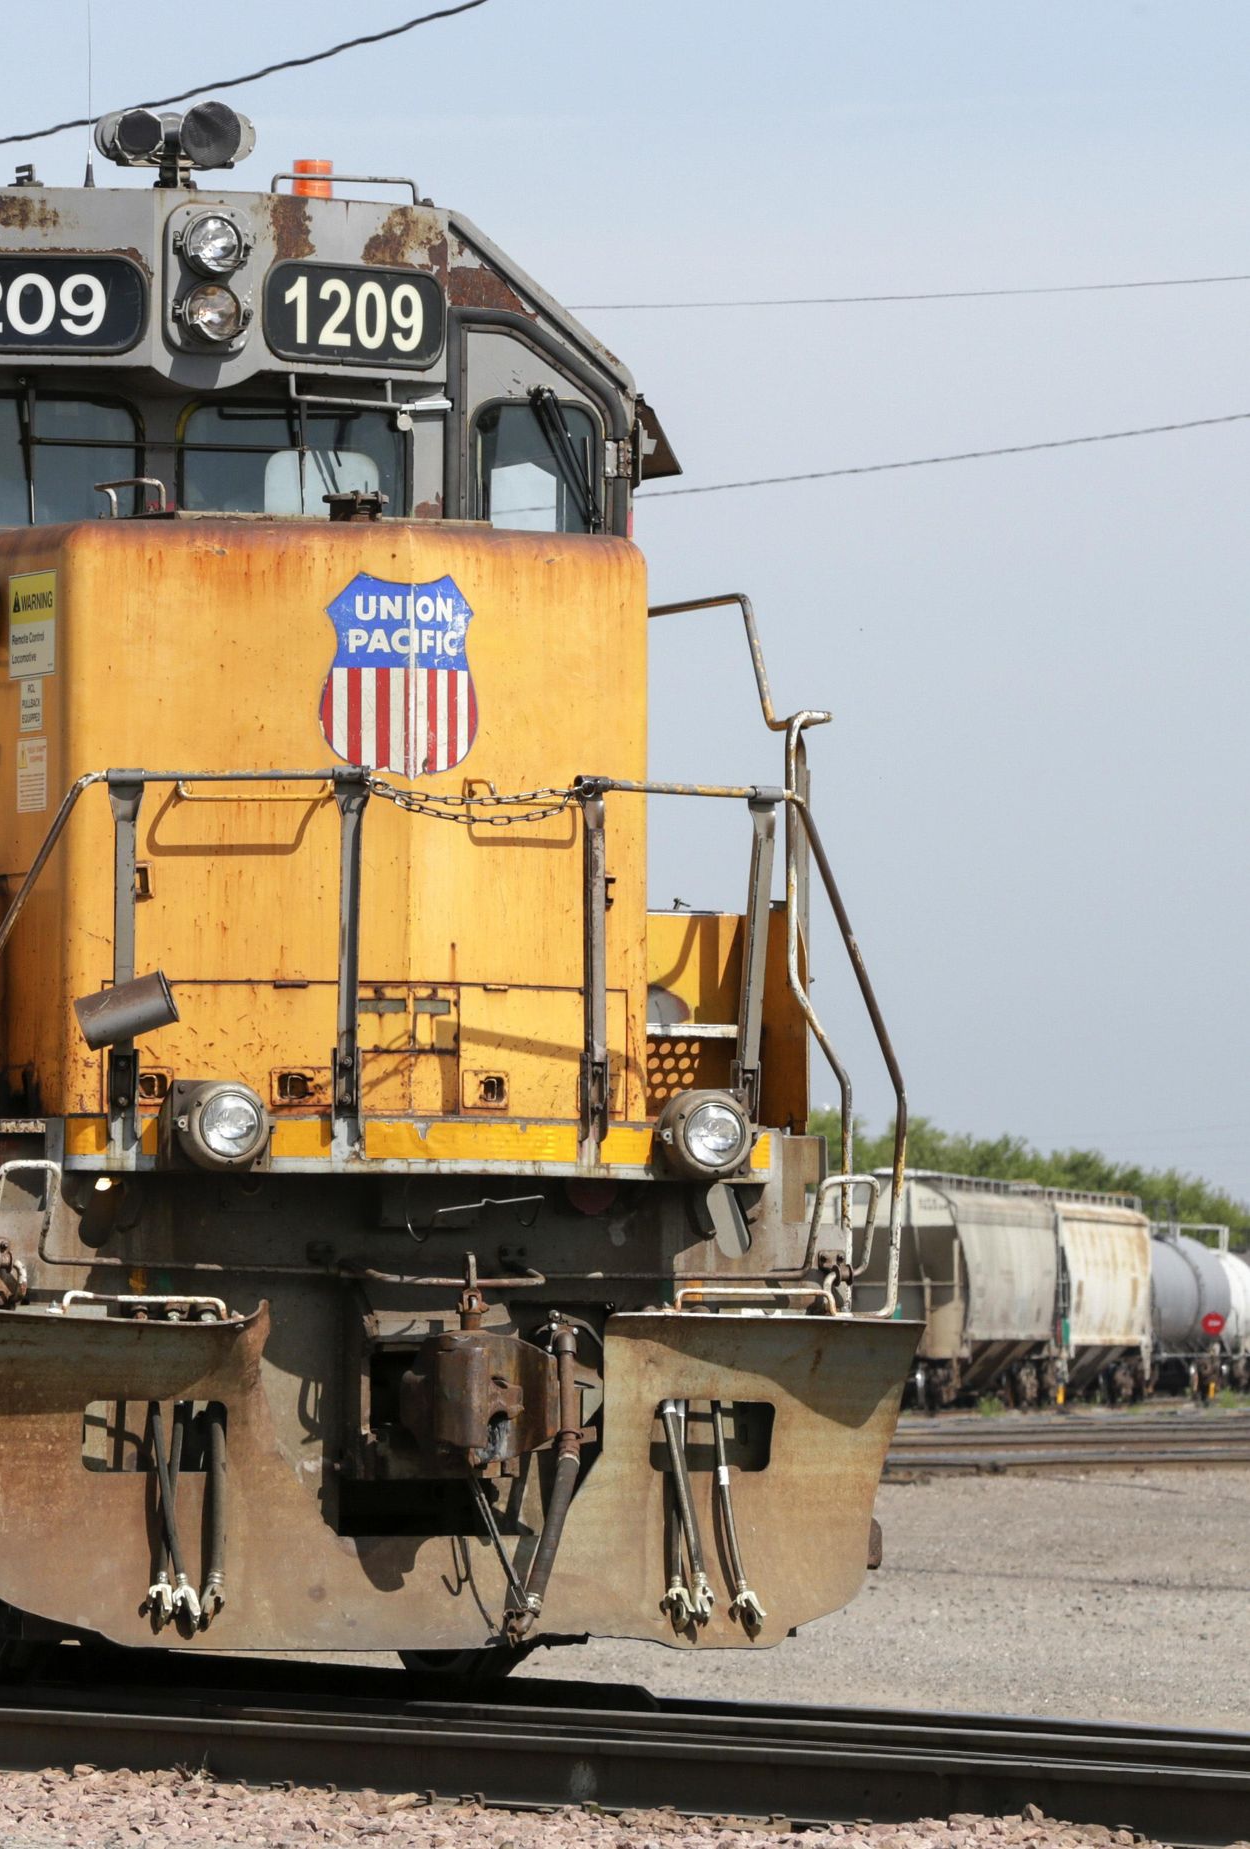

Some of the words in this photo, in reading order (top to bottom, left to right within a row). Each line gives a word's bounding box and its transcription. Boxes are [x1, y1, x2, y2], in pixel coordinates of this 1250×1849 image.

[284, 276, 424, 352] 1209
[21, 591, 53, 612] WARNING
[355, 595, 453, 622] UNION
[12, 633, 28, 646] Remote
[29, 631, 45, 644] Control
[348, 628, 459, 657] PACIFIC
[12, 653, 37, 665] Locomotive
